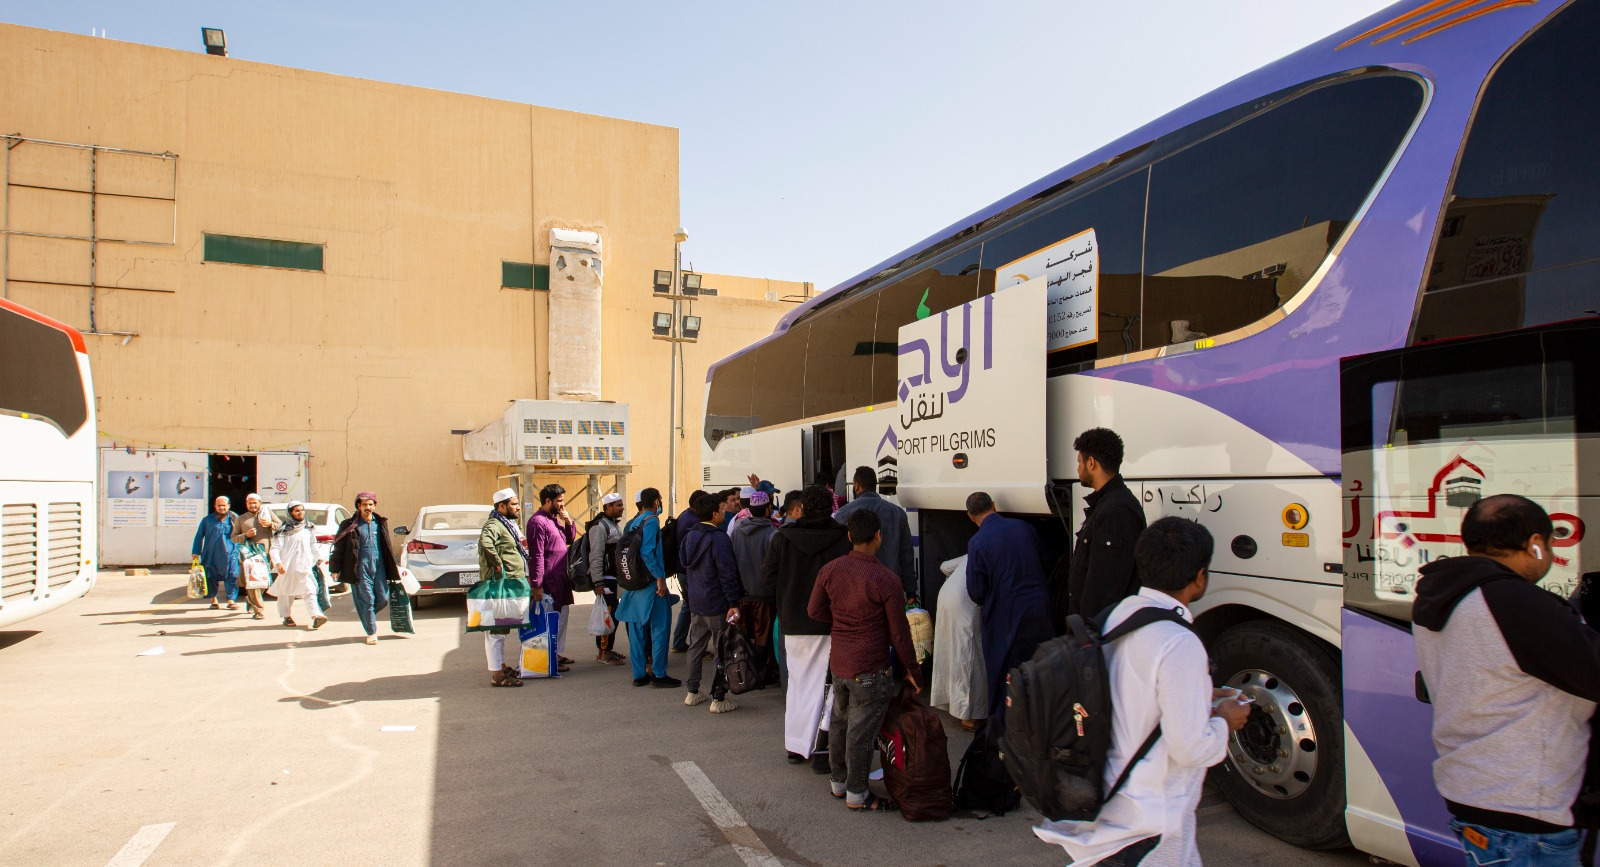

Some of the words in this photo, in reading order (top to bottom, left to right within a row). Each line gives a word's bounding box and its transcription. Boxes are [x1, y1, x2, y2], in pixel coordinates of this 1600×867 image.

[1072, 260, 1093, 281] فجر
[900, 392, 944, 430] لنقل
[930, 427, 996, 453] PILGRIMS
[1170, 484, 1223, 513] راكب
